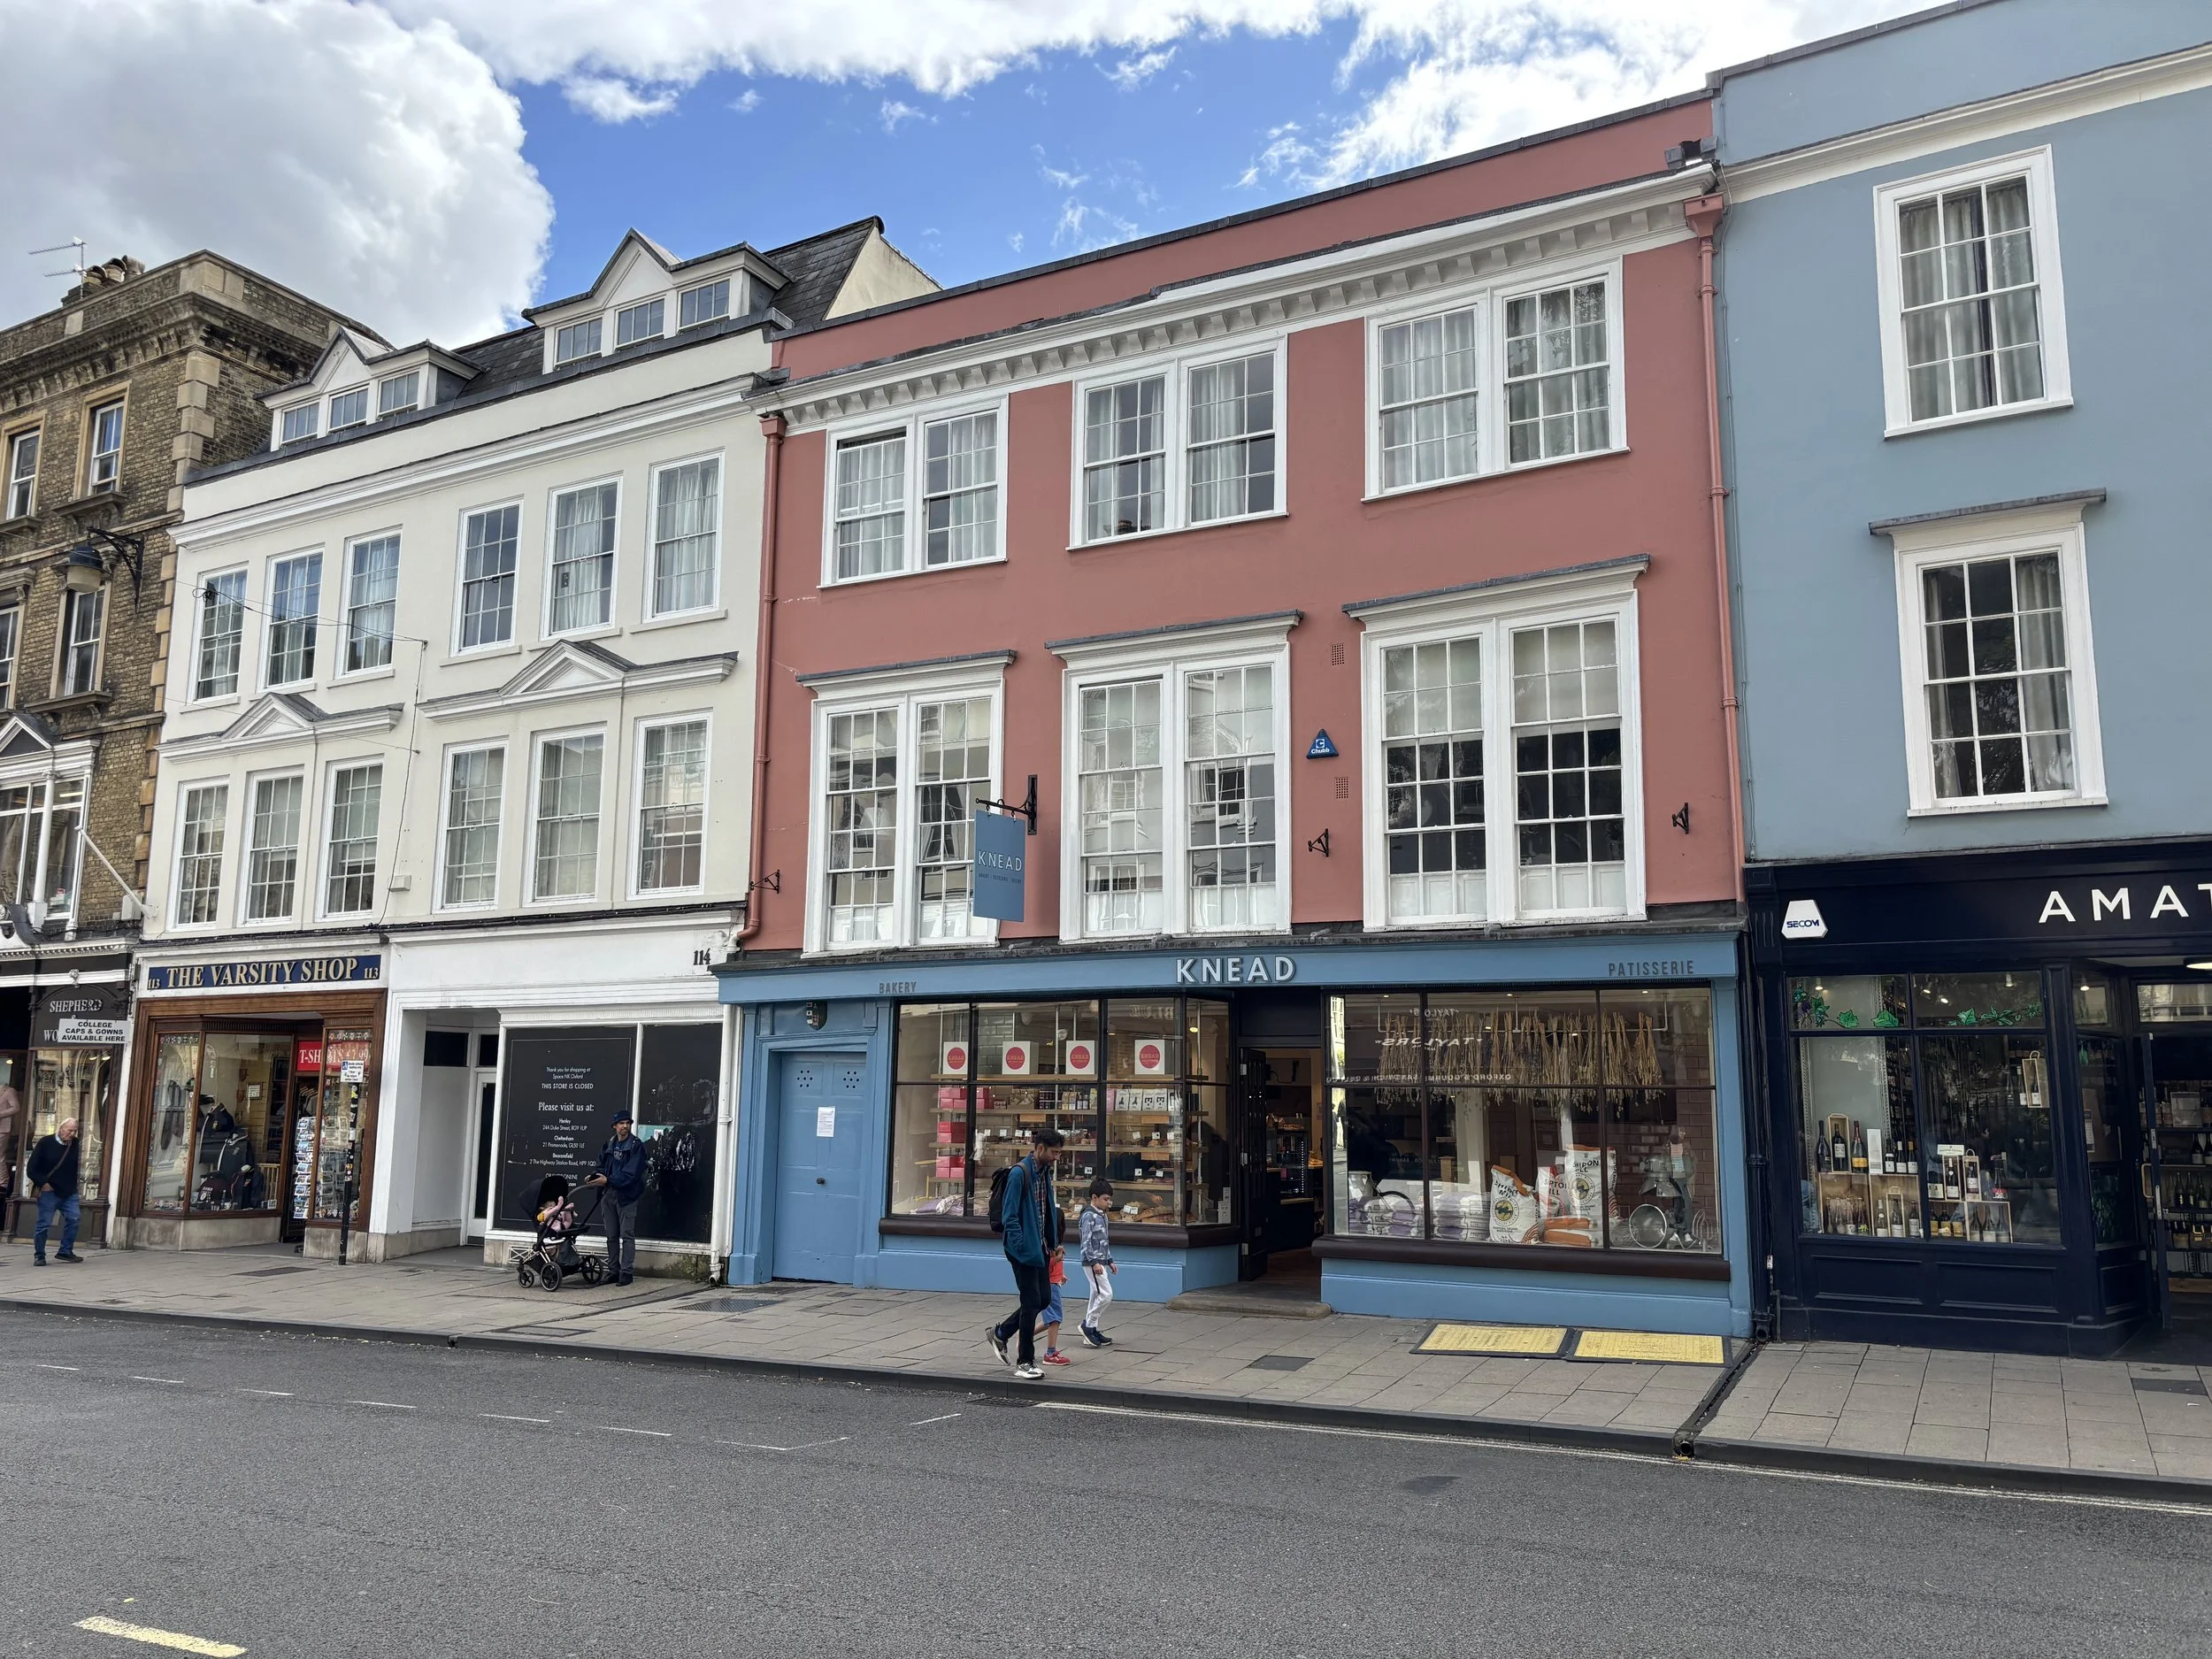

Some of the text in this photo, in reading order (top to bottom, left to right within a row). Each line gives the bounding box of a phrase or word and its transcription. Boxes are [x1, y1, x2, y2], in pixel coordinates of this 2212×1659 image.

[978, 849, 1023, 872] KNEAD
[1786, 918, 1820, 928] SECOM
[693, 947, 711, 965] 114
[147, 957, 379, 989] 113 THE VARSITY SHOP 113
[1176, 956, 1296, 984] KNEAD
[1608, 960, 1694, 977] PATISSERIE
[879, 981, 918, 994] BAKERY
[50, 999, 103, 1013] SHEPHERD
[538, 1102, 558, 1111] Please
[560, 1102, 574, 1111] visit
